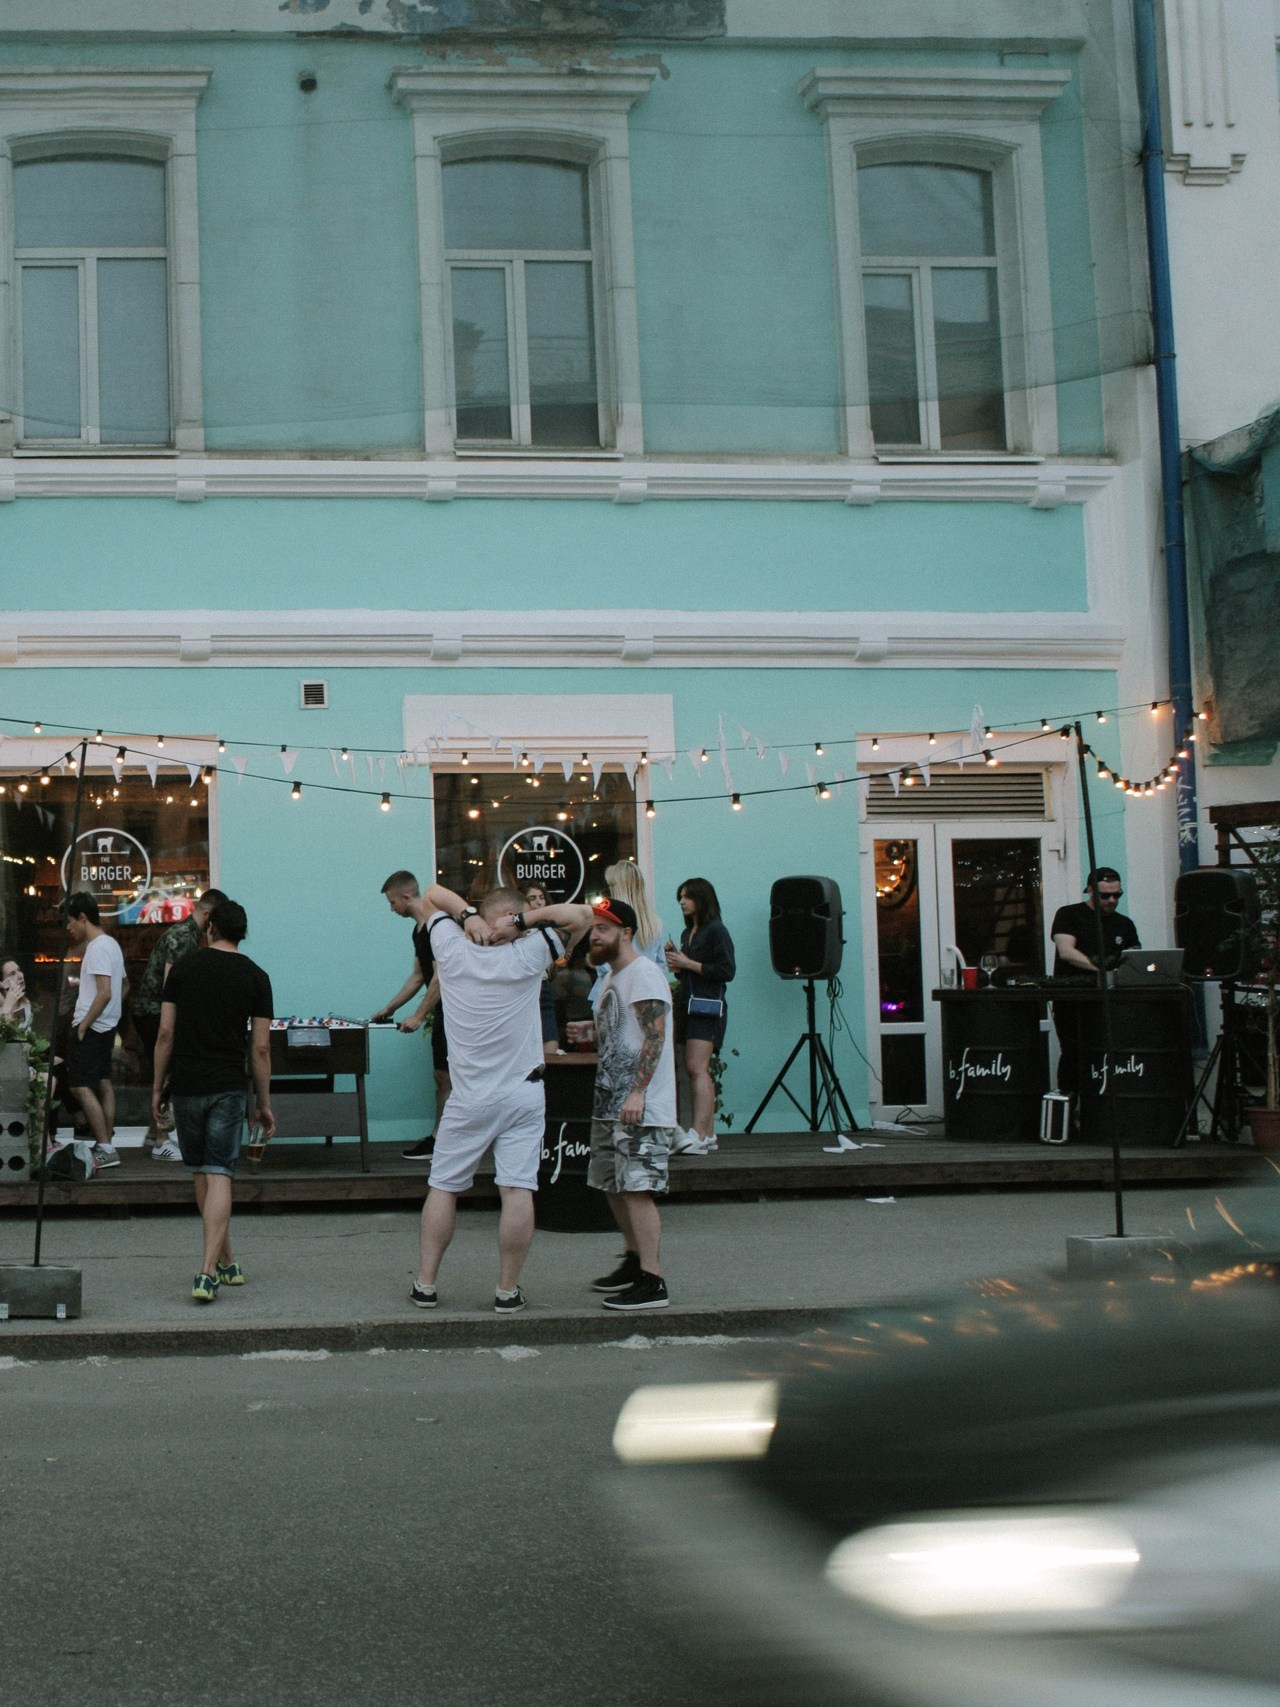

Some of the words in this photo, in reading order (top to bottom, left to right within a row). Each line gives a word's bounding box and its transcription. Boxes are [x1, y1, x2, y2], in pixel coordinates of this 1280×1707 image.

[80, 865, 132, 881] BURGER
[516, 863, 567, 879] BURGER
[949, 1047, 1011, 1100] b.family
[1091, 1053, 1144, 1095] b.fmily
[540, 1121, 591, 1184] b.fam
